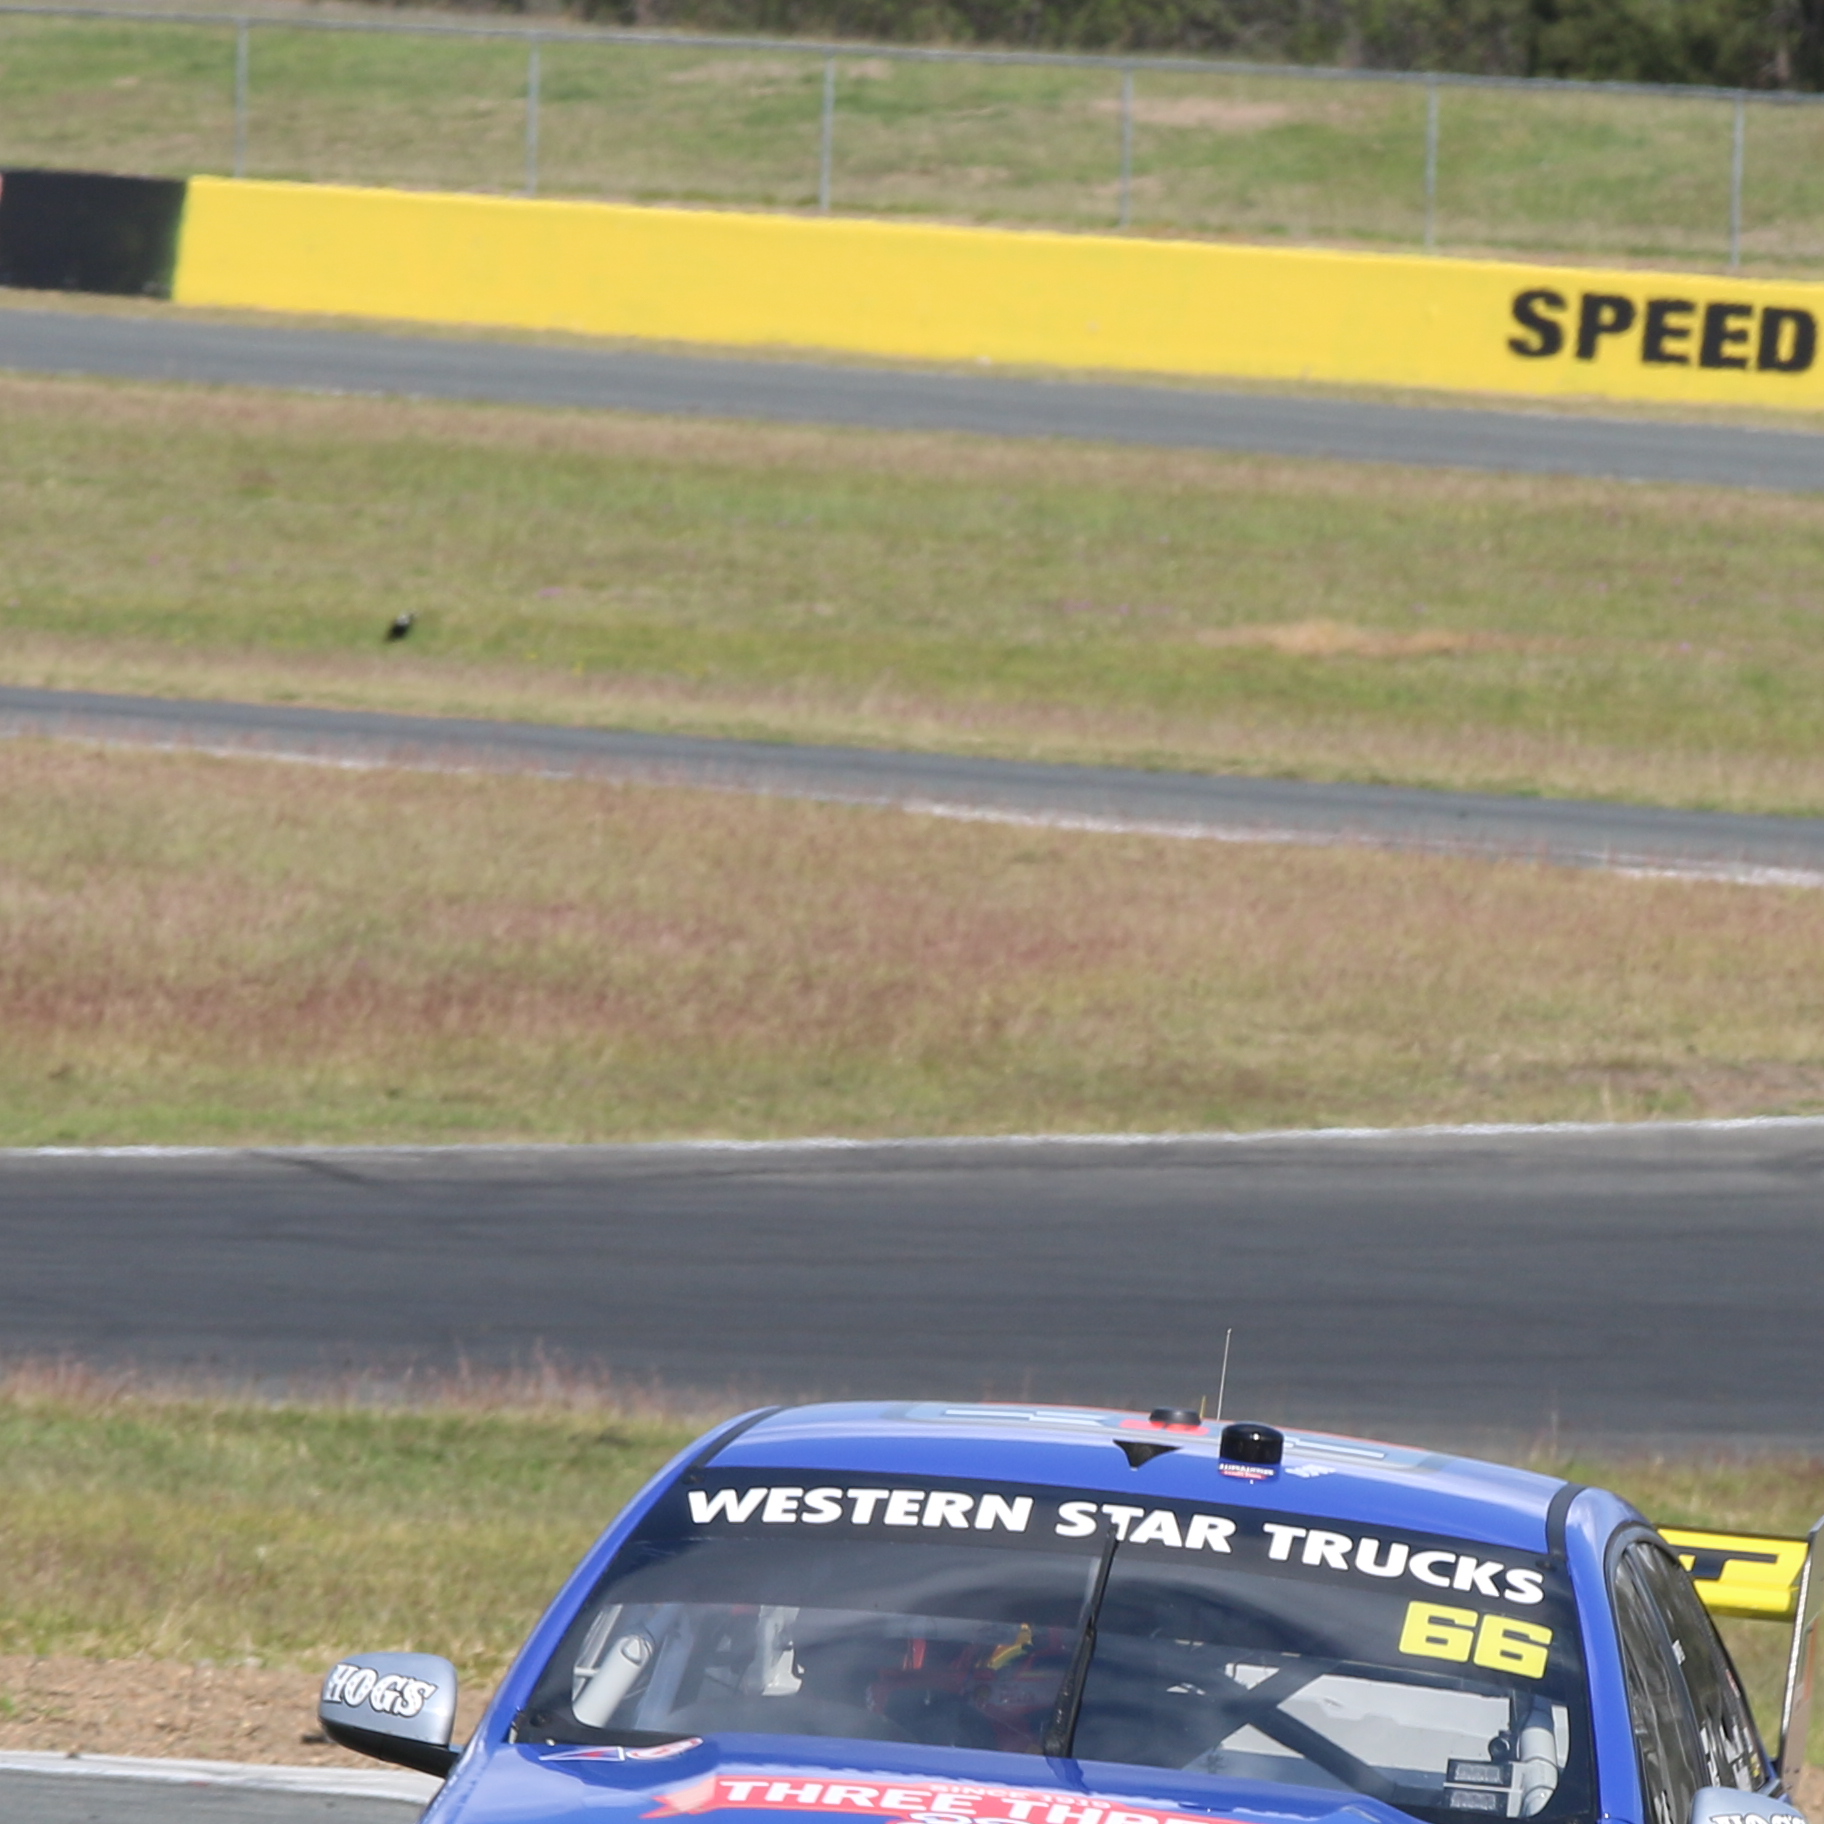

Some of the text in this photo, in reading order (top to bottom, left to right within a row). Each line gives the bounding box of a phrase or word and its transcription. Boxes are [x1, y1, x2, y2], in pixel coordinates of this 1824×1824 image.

[1508, 288, 1818, 374] SPEED
[687, 1486, 1545, 1605] WESTERN STAR TRUCKS
[1398, 1600, 1554, 1680] 66
[324, 1663, 438, 1718] HOGS
[718, 1780, 983, 1815] THREE
